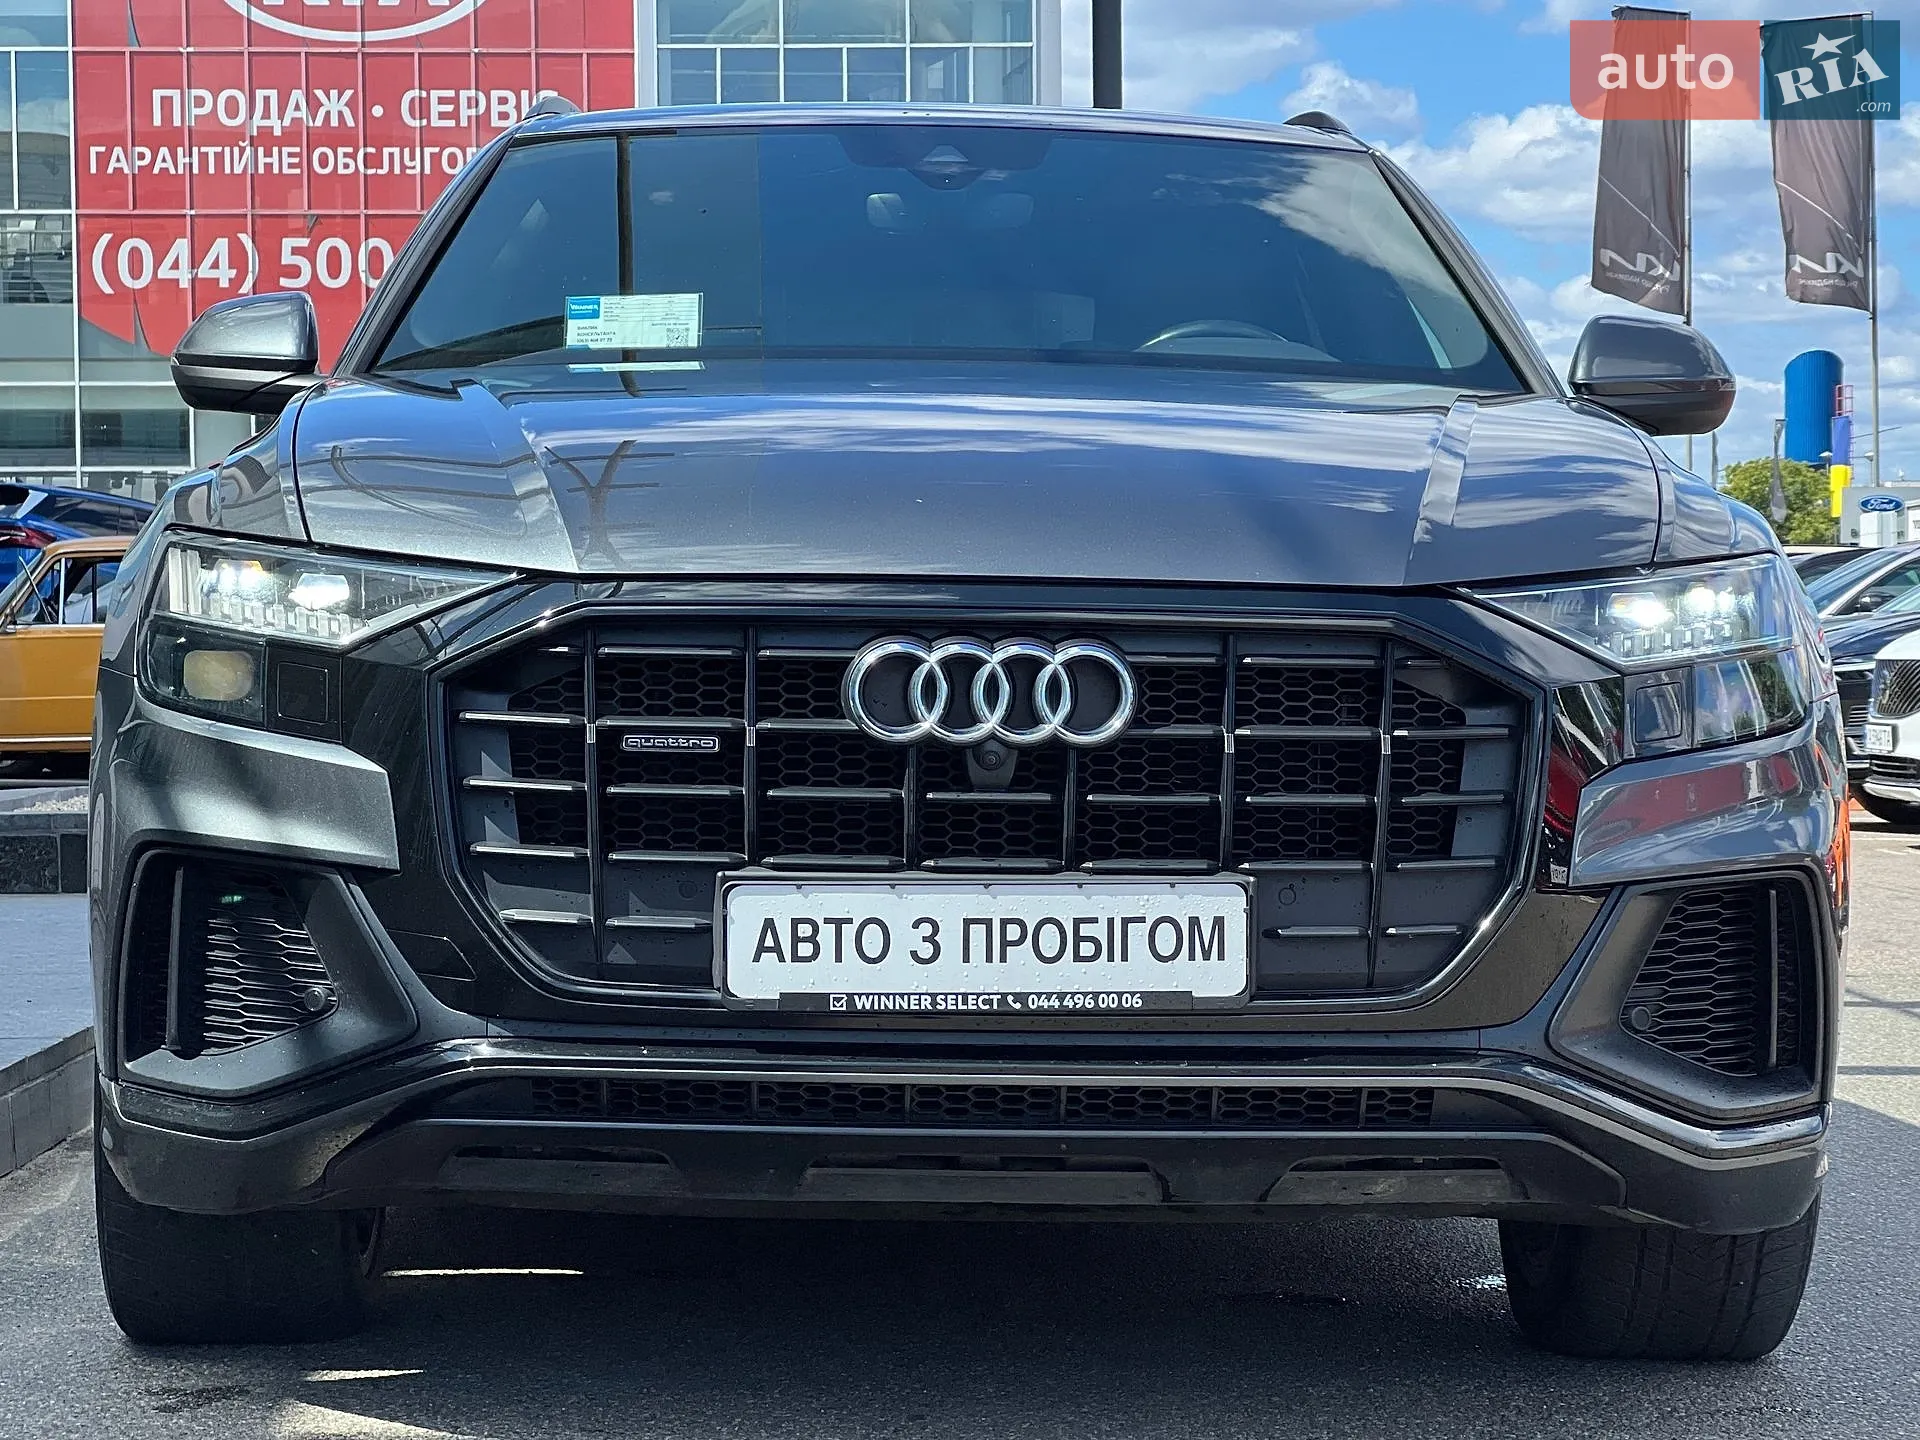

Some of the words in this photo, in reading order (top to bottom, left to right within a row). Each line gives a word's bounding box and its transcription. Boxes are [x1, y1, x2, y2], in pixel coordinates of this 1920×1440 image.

[152, 88, 355, 136] ПРОДАЖ
[400, 88, 559, 129] СЕРВІ
[89, 140, 300, 176] ГАРАНТІЙНЕ
[312, 146, 480, 176] ОБСЛУГО
[91, 232, 259, 295] (044)
[279, 237, 395, 289] 500
[1867, 497, 1897, 510] Ford
[627, 738, 714, 748] quattro
[752, 916, 891, 965] АВТО
[962, 915, 1226, 964] ПРОБІГОМ
[854, 994, 931, 1011] WINNER
[936, 994, 1001, 1010] SELECT
[1028, 994, 1060, 1010] 044
[1062, 993, 1095, 1009] 496
[1098, 993, 1119, 1009] 00
[1122, 993, 1143, 1009] 06
